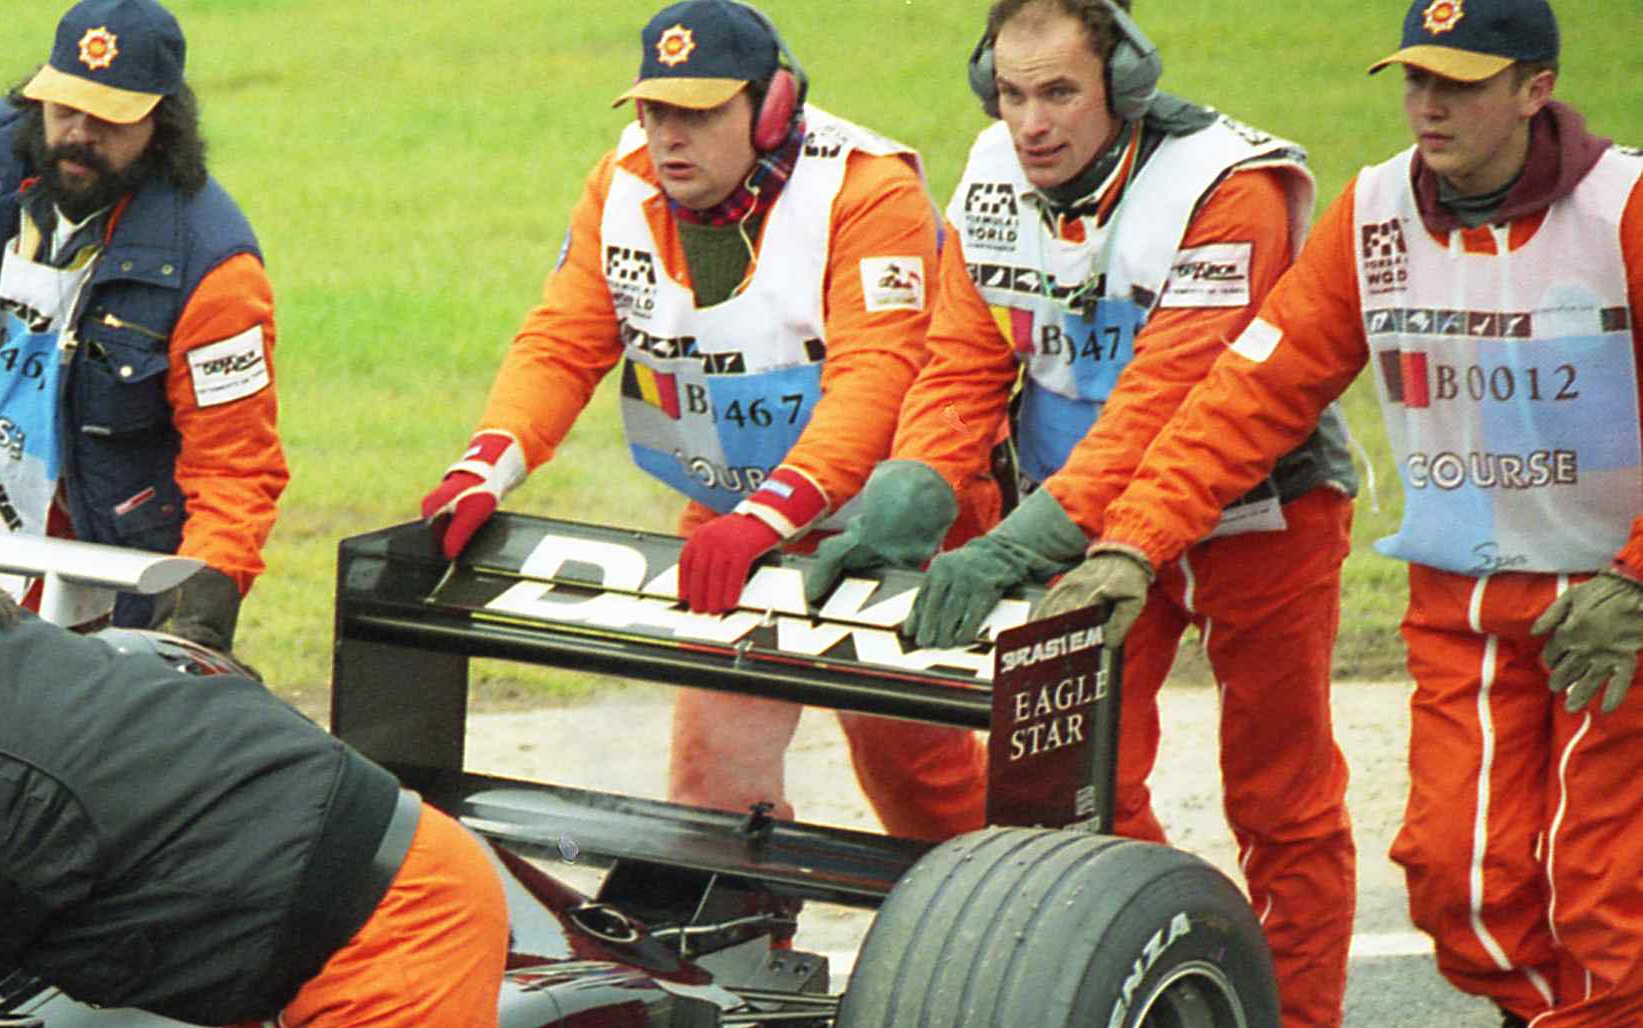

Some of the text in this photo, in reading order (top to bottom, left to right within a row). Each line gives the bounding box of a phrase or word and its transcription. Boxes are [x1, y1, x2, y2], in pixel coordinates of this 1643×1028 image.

[1436, 364, 1580, 401] B0012
[1407, 448, 1578, 489] COURSE
[1001, 625, 1104, 673] BRASTEM
[1013, 671, 1109, 723] EAGLE
[1010, 714, 1084, 761] STAR
